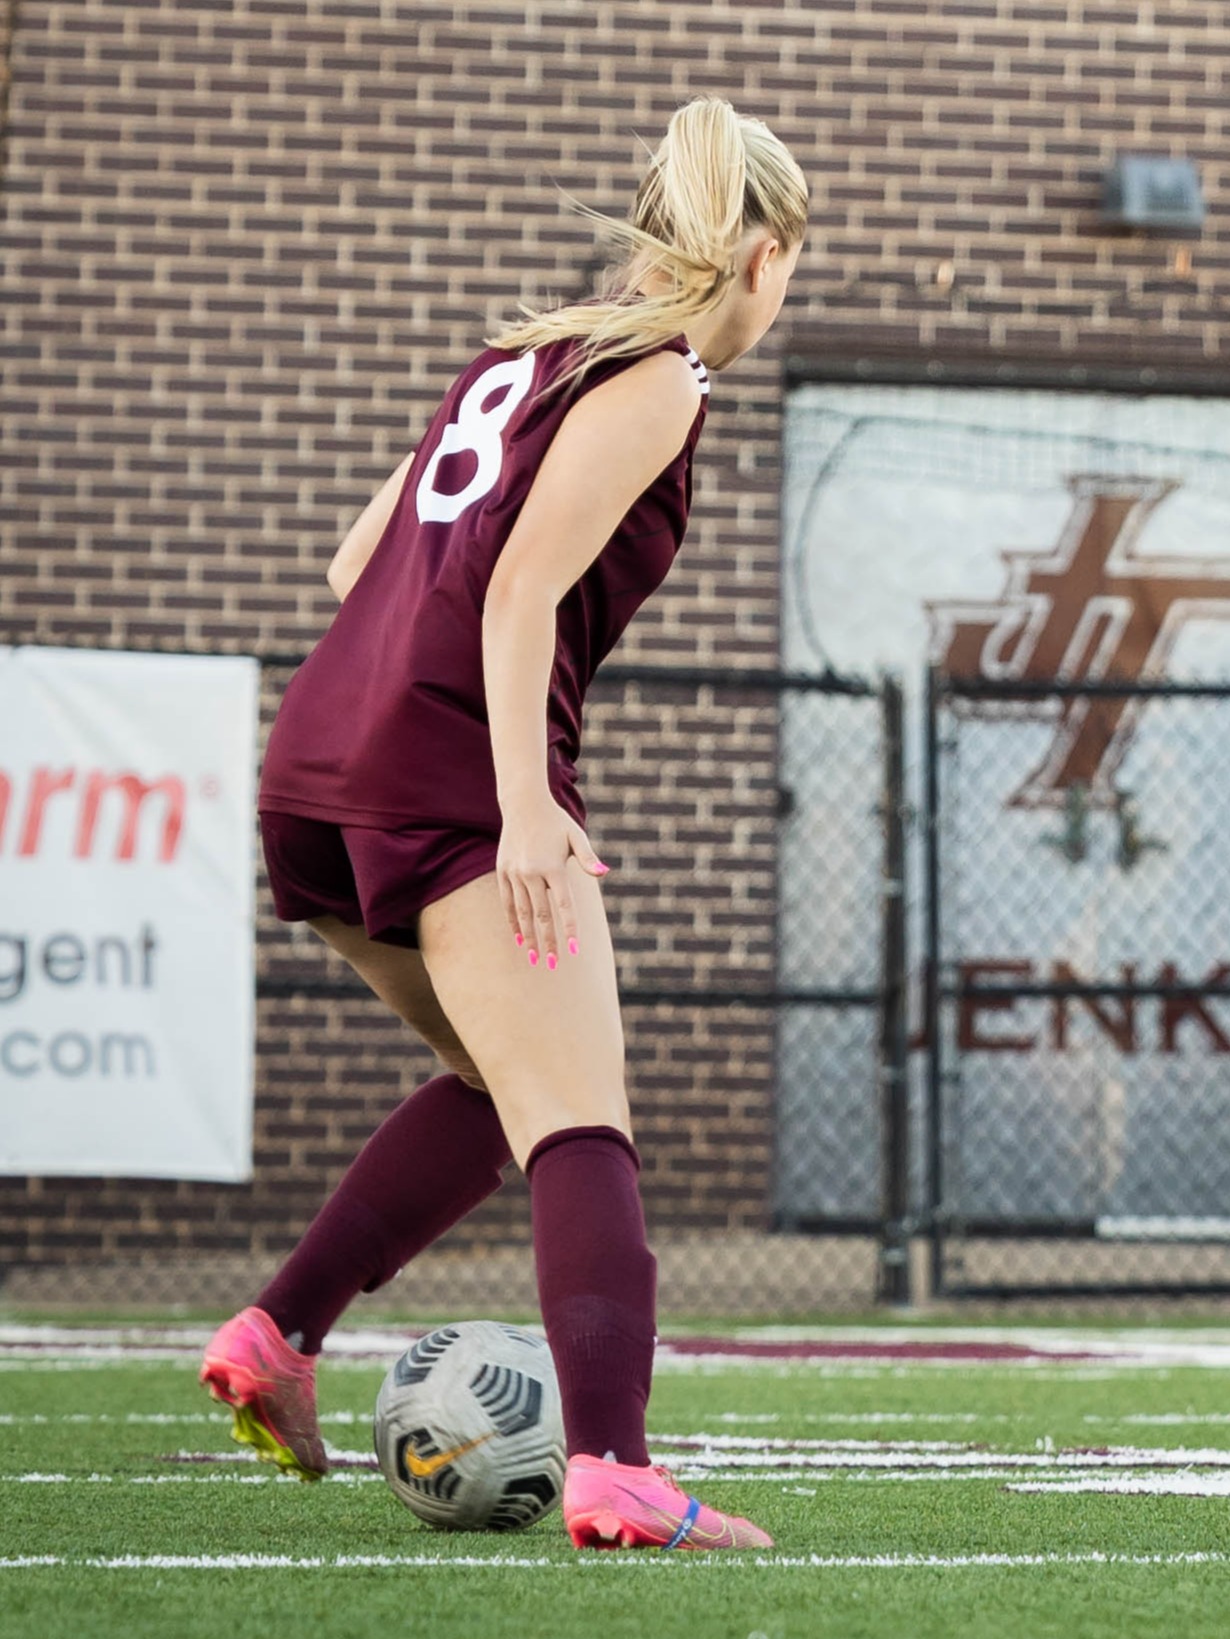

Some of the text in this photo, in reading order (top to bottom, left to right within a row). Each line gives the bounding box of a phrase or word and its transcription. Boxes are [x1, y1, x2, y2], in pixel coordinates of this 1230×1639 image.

[415, 349, 536, 525] 8
[0, 764, 187, 864] rm
[0, 1027, 157, 1081] com
